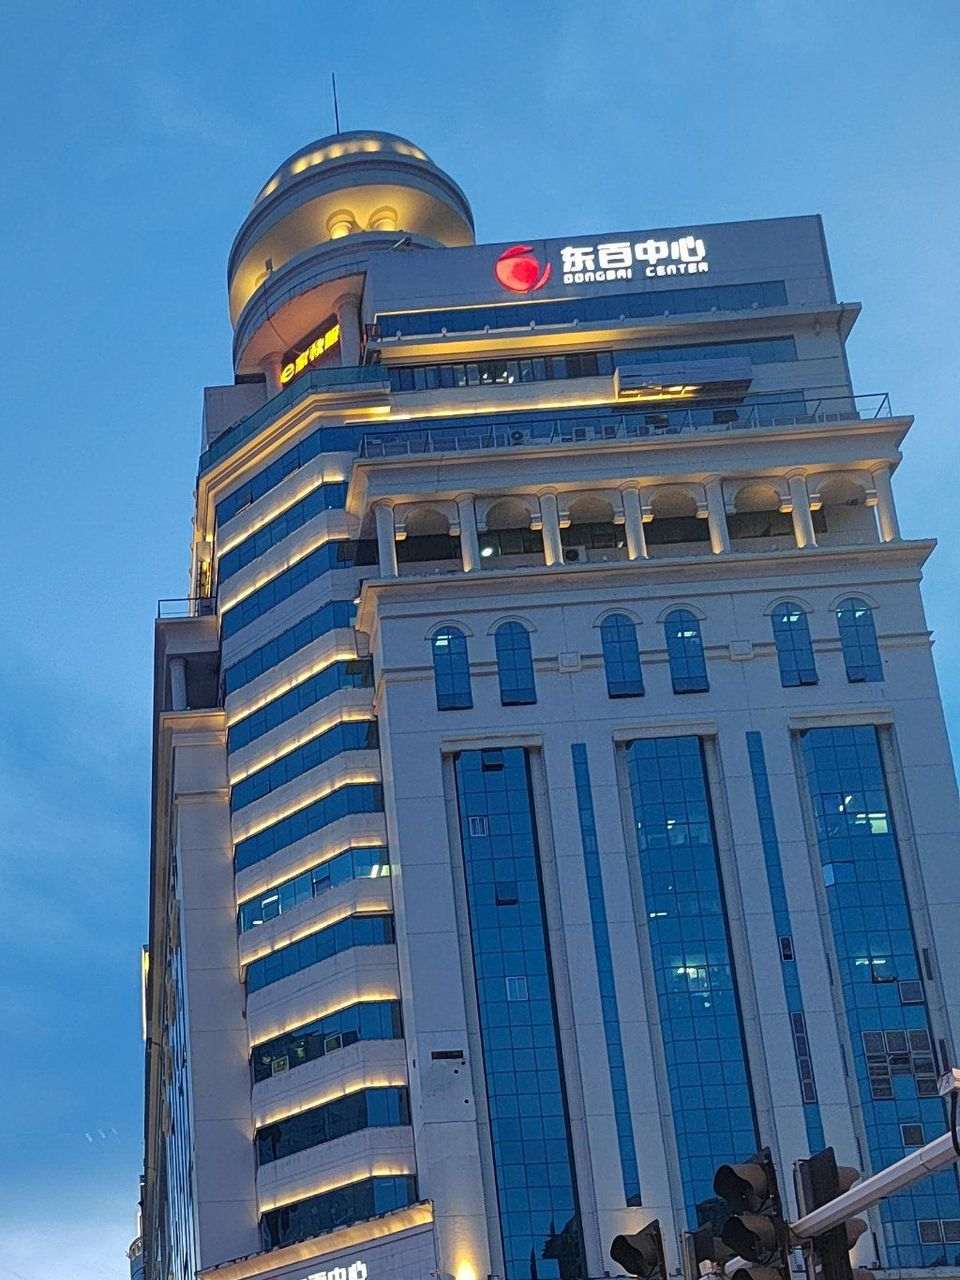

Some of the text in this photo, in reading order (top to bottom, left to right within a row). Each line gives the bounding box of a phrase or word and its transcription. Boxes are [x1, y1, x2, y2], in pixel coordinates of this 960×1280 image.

[560, 236, 706, 273] 东百中心
[563, 262, 709, 284] DONGBAI CENTER
